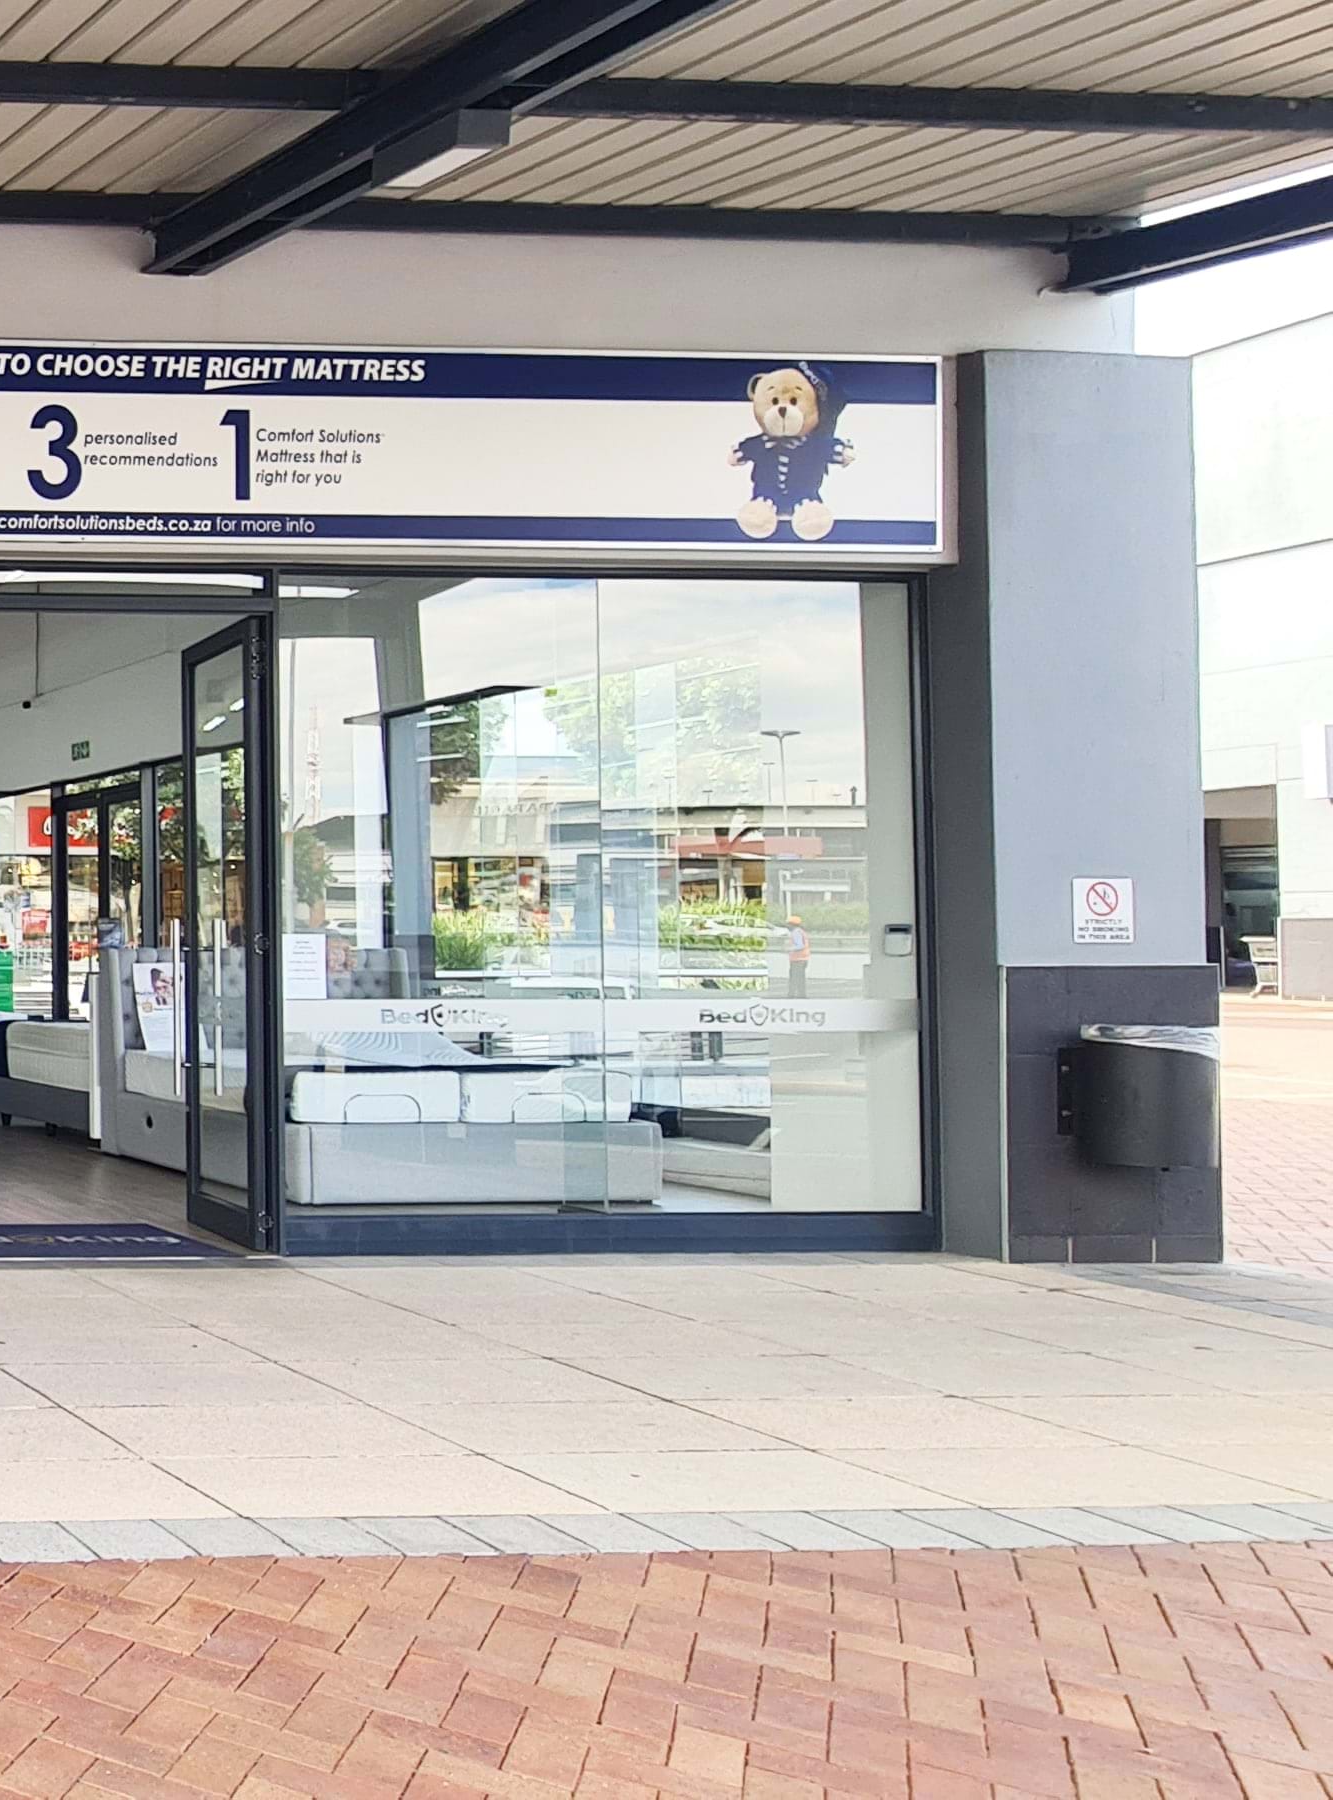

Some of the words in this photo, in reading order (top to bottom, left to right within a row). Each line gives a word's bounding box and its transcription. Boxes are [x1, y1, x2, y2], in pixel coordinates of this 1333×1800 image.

[35, 353, 146, 378] CHOOSE
[151, 355, 203, 378] THE
[206, 356, 288, 380] RIGHT
[291, 357, 426, 382] MATTRESS
[84, 431, 178, 450] personalised
[255, 428, 314, 444] Comfort
[318, 429, 380, 445] Solutions
[26, 404, 82, 501] 3
[84, 452, 219, 468] recommendations
[219, 409, 251, 500] 1
[255, 449, 314, 465] Mattress
[319, 450, 349, 466] that
[352, 450, 362, 466] is
[255, 470, 287, 488] right
[291, 470, 310, 486] for
[312, 474, 342, 487] you
[215, 516, 237, 533] for
[241, 520, 280, 533] more
[284, 517, 315, 534] info
[380, 1008, 430, 1025] Bed
[699, 1009, 749, 1025] Bed
[770, 1009, 827, 1026] King
